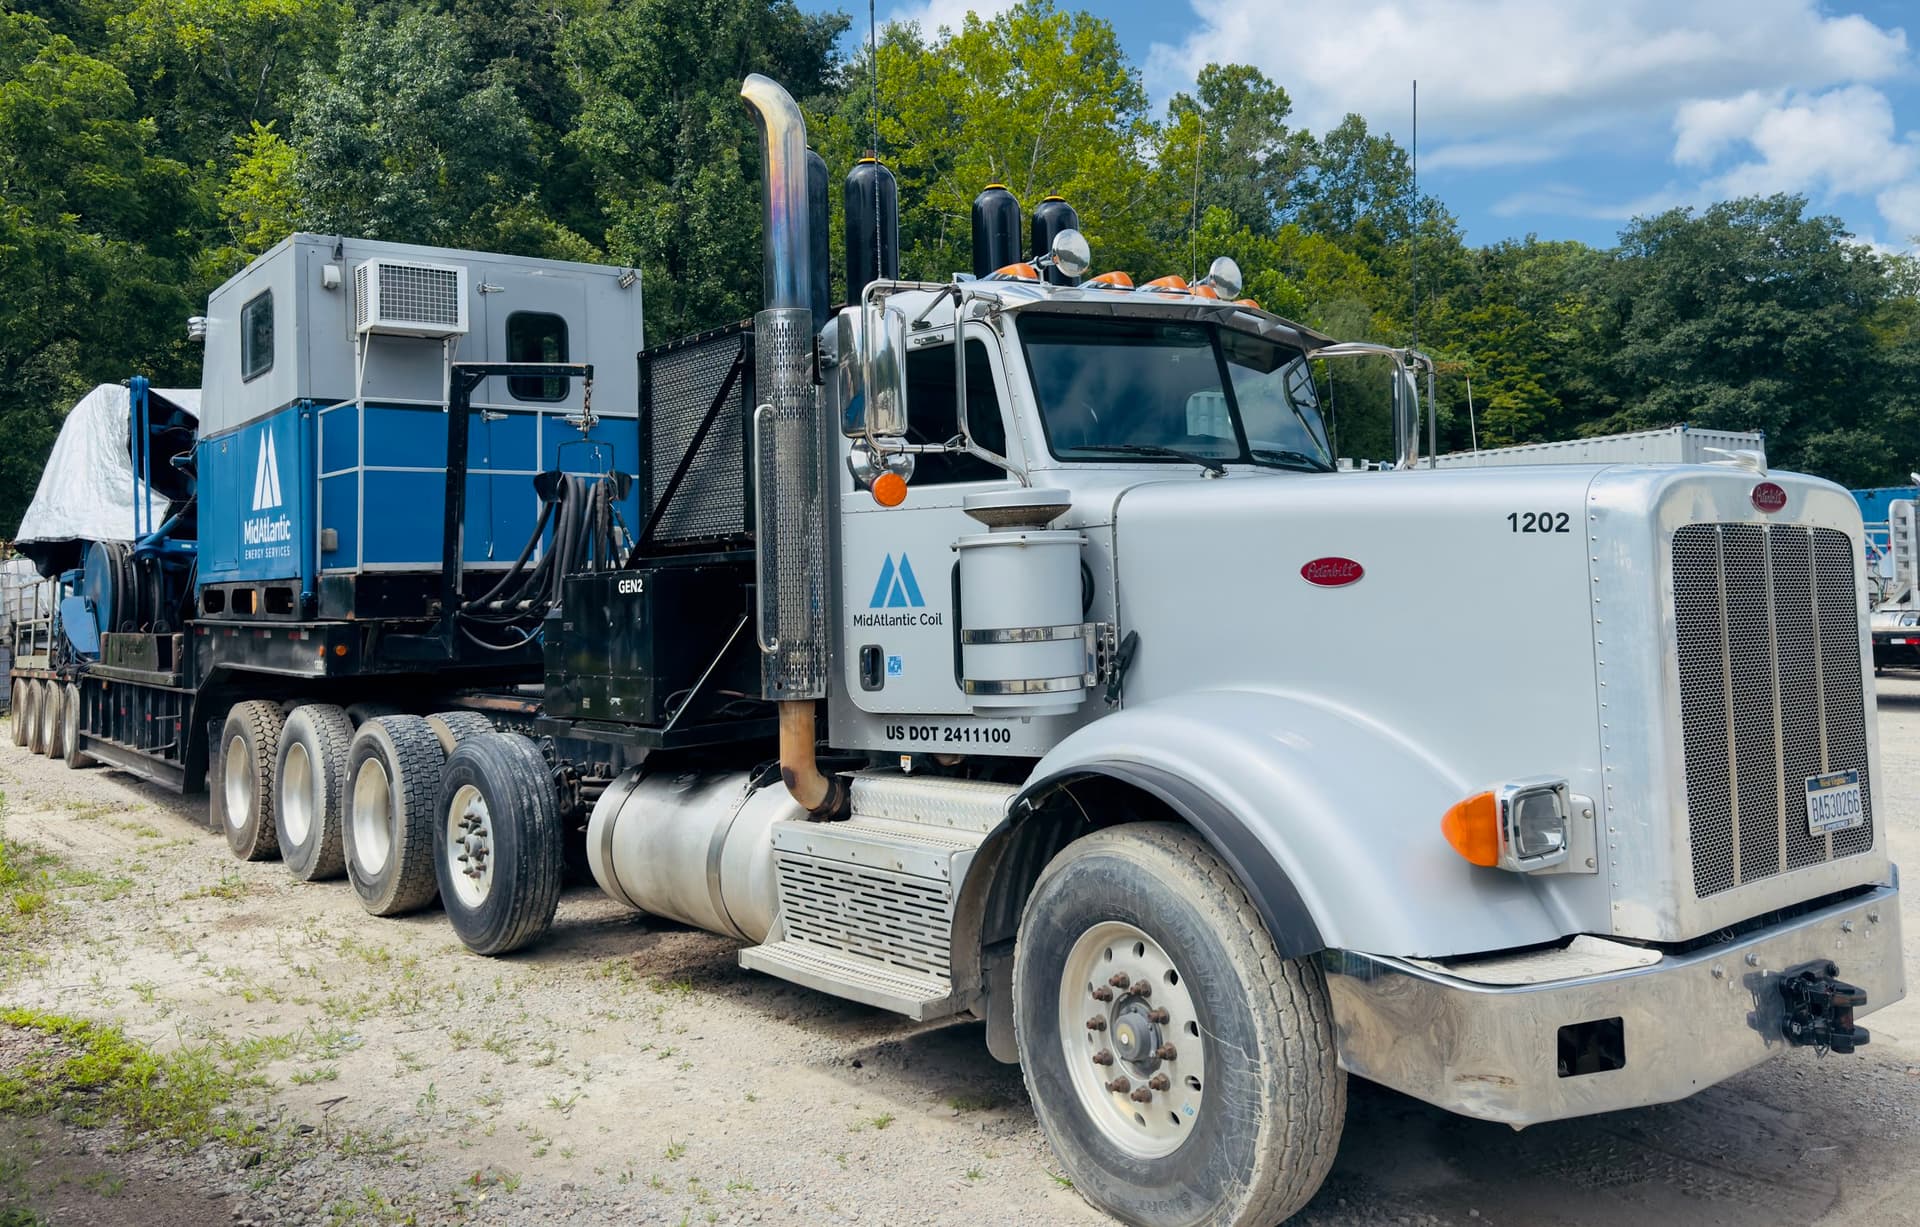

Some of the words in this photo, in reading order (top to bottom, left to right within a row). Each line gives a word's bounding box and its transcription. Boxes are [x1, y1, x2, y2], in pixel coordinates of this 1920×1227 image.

[244, 513, 291, 545] MidAtlantic
[1507, 512, 1570, 533] 1202
[245, 548, 264, 560] ENERGY
[265, 545, 290, 558] SERVICES
[1307, 562, 1358, 580] Peterbilt
[618, 578, 644, 594] GEN2
[853, 613, 917, 627] MidAtlantic
[919, 612, 943, 626] Coil
[886, 725, 905, 740] US
[909, 726, 939, 741] DOT
[943, 727, 1011, 743] 2411100
[1811, 789, 1861, 823] BA530266
